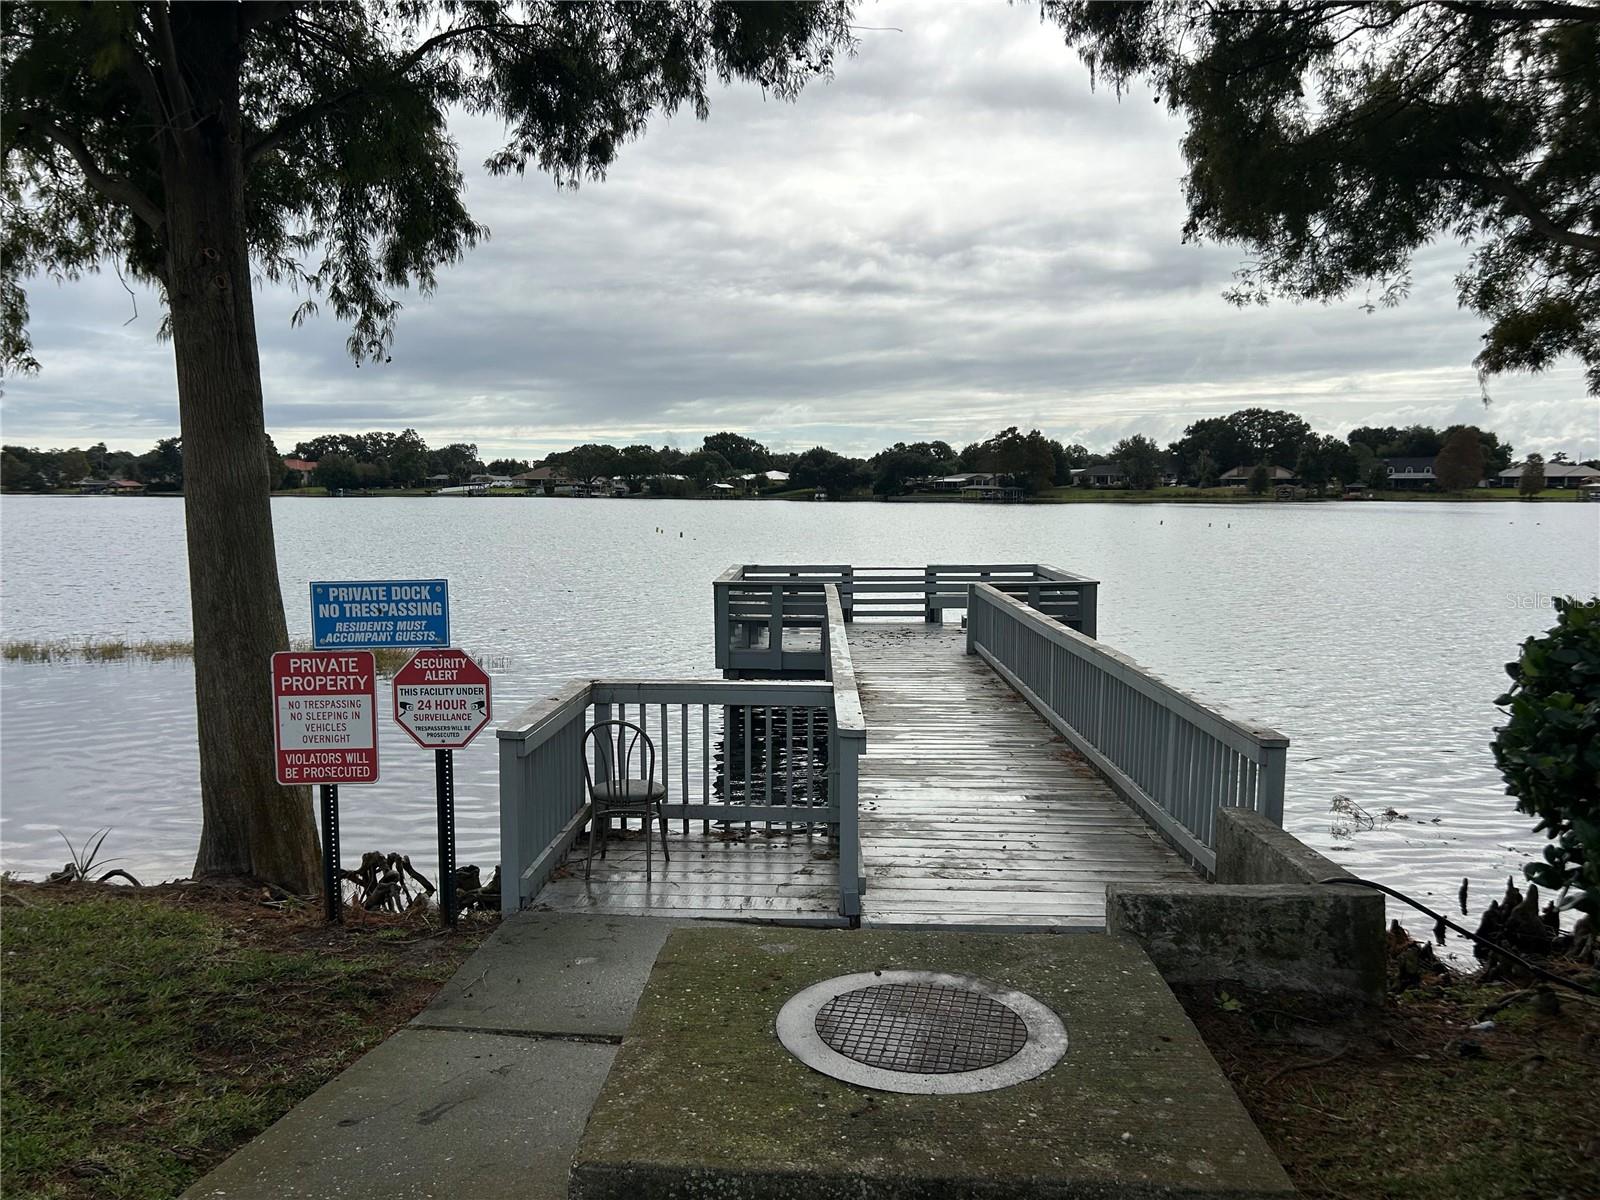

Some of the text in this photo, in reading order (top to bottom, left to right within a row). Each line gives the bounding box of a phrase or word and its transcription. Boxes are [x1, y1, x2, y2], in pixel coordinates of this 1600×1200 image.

[329, 586, 430, 601] PRIVATE DOCK
[319, 602, 442, 617] NO TRESPASSING
[336, 621, 426, 631] RESIDENTS MUST
[326, 632, 391, 642] ACCOMPANY
[290, 658, 358, 673] PRIVATE
[414, 658, 467, 669] SECURITY
[425, 670, 457, 681] ALERT
[282, 676, 368, 691] PROPERTY
[400, 688, 418, 696] THIS
[420, 688, 455, 696] FACILITY
[288, 700, 361, 709] NO TRESPASSING
[418, 700, 467, 710] 24 HOUR
[290, 712, 360, 720] NO SLEEPING IN
[413, 713, 472, 721] SURVEILLANCE
[305, 723, 346, 732] VEHICLES
[303, 735, 350, 743] OVERNIGHT
[285, 753, 368, 765] VIOLATORS WILL
[285, 766, 370, 779] BE PROSECUTED
